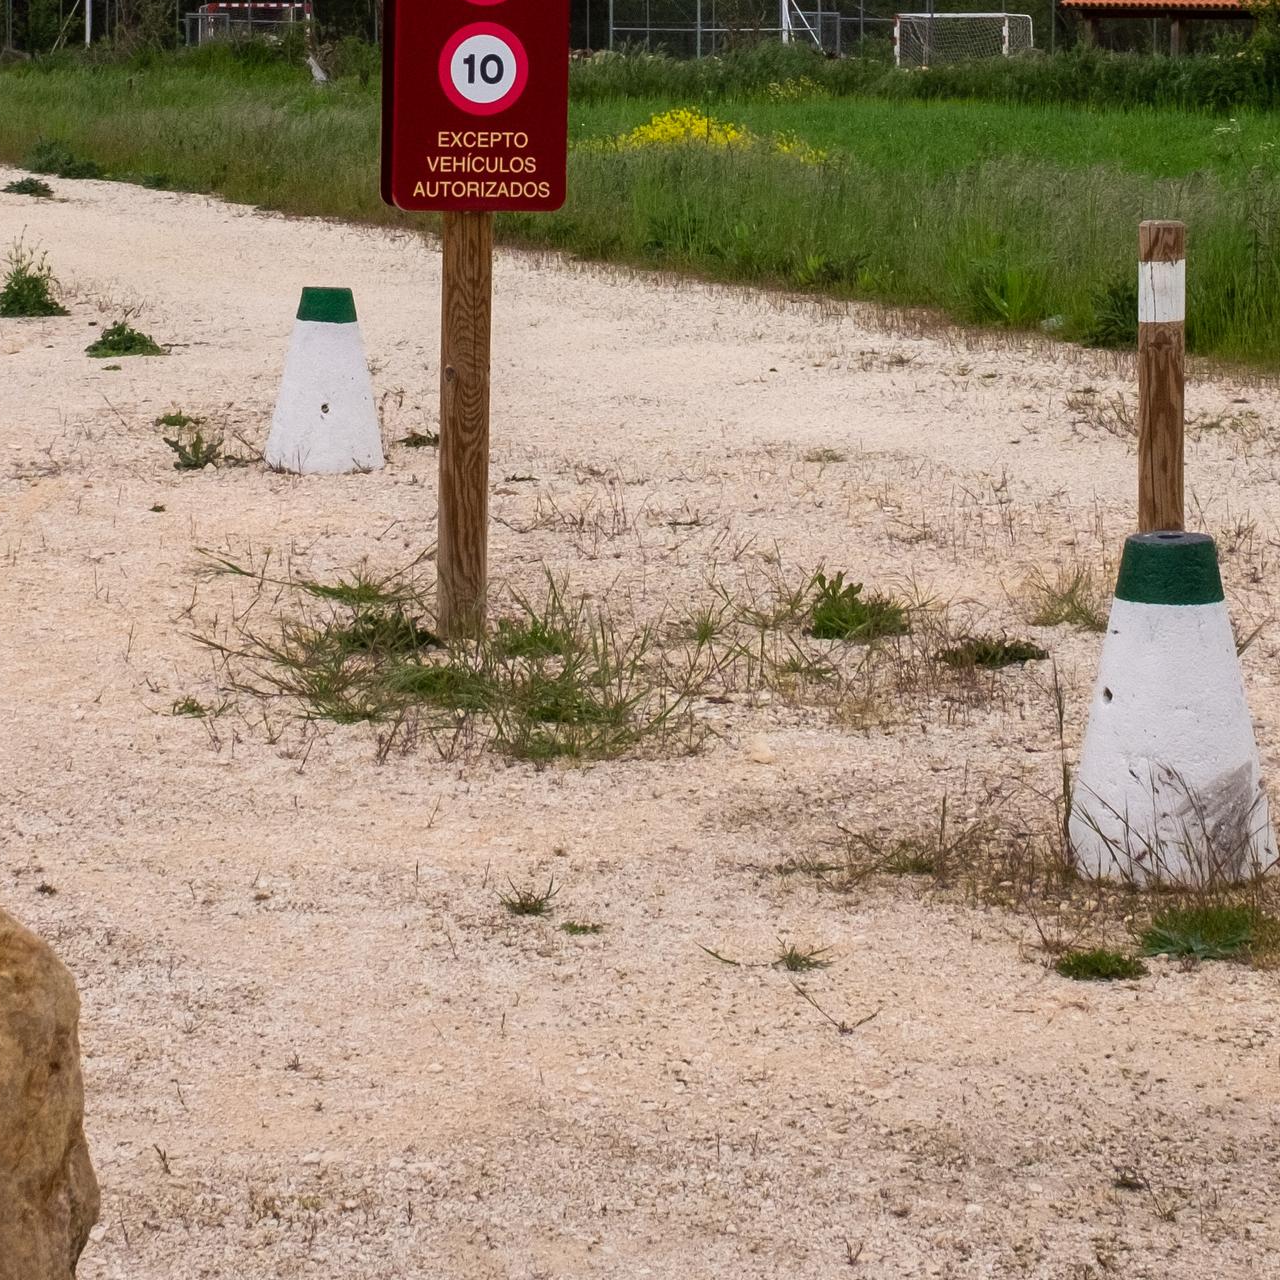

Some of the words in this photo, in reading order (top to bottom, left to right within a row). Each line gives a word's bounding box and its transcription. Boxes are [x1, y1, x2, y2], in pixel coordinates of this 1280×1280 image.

[463, 53, 505, 85] 10
[437, 131, 529, 149] EXCEPTO
[426, 152, 537, 174] VEHÍCULOS
[412, 180, 551, 199] AUTORIZADOS
